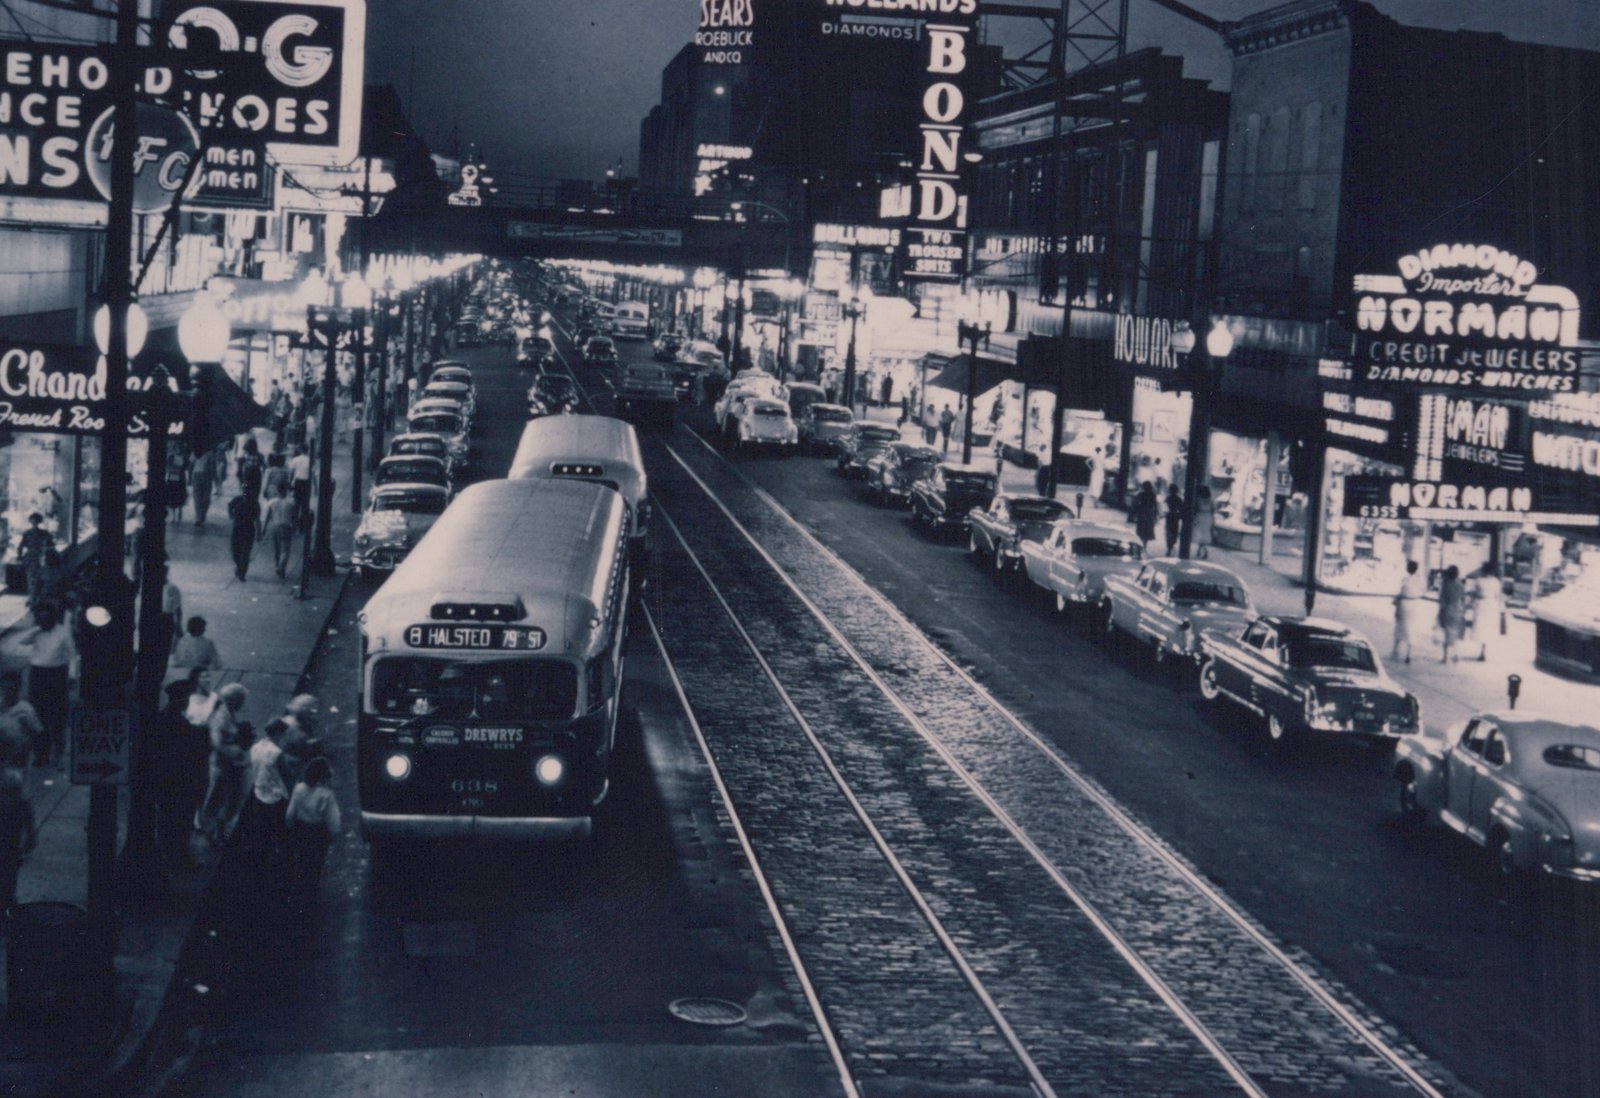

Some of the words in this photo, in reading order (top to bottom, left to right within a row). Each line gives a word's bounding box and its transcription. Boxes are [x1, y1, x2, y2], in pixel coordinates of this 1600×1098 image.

[700, 0, 754, 27] SEARS
[695, 31, 753, 46] ROEBUCK
[821, 22, 914, 40] DIAMONDS
[6, 52, 173, 95] EHOD
[183, 91, 330, 135] HOES
[917, 29, 966, 222] BOND
[206, 147, 256, 166] men
[922, 231, 952, 246] TWO
[908, 244, 963, 260] TROUSER
[1398, 243, 1537, 287] DIAMOND
[1356, 296, 1561, 342] NORMAN
[1369, 340, 1451, 364] CREDIT
[1456, 347, 1577, 372] JEWELERS
[67, 405, 107, 430] Roo
[1389, 482, 1532, 512] NORMAN
[427, 629, 491, 648] HALSTED
[464, 728, 524, 743] DREWRYS
[451, 779, 498, 794] 638
